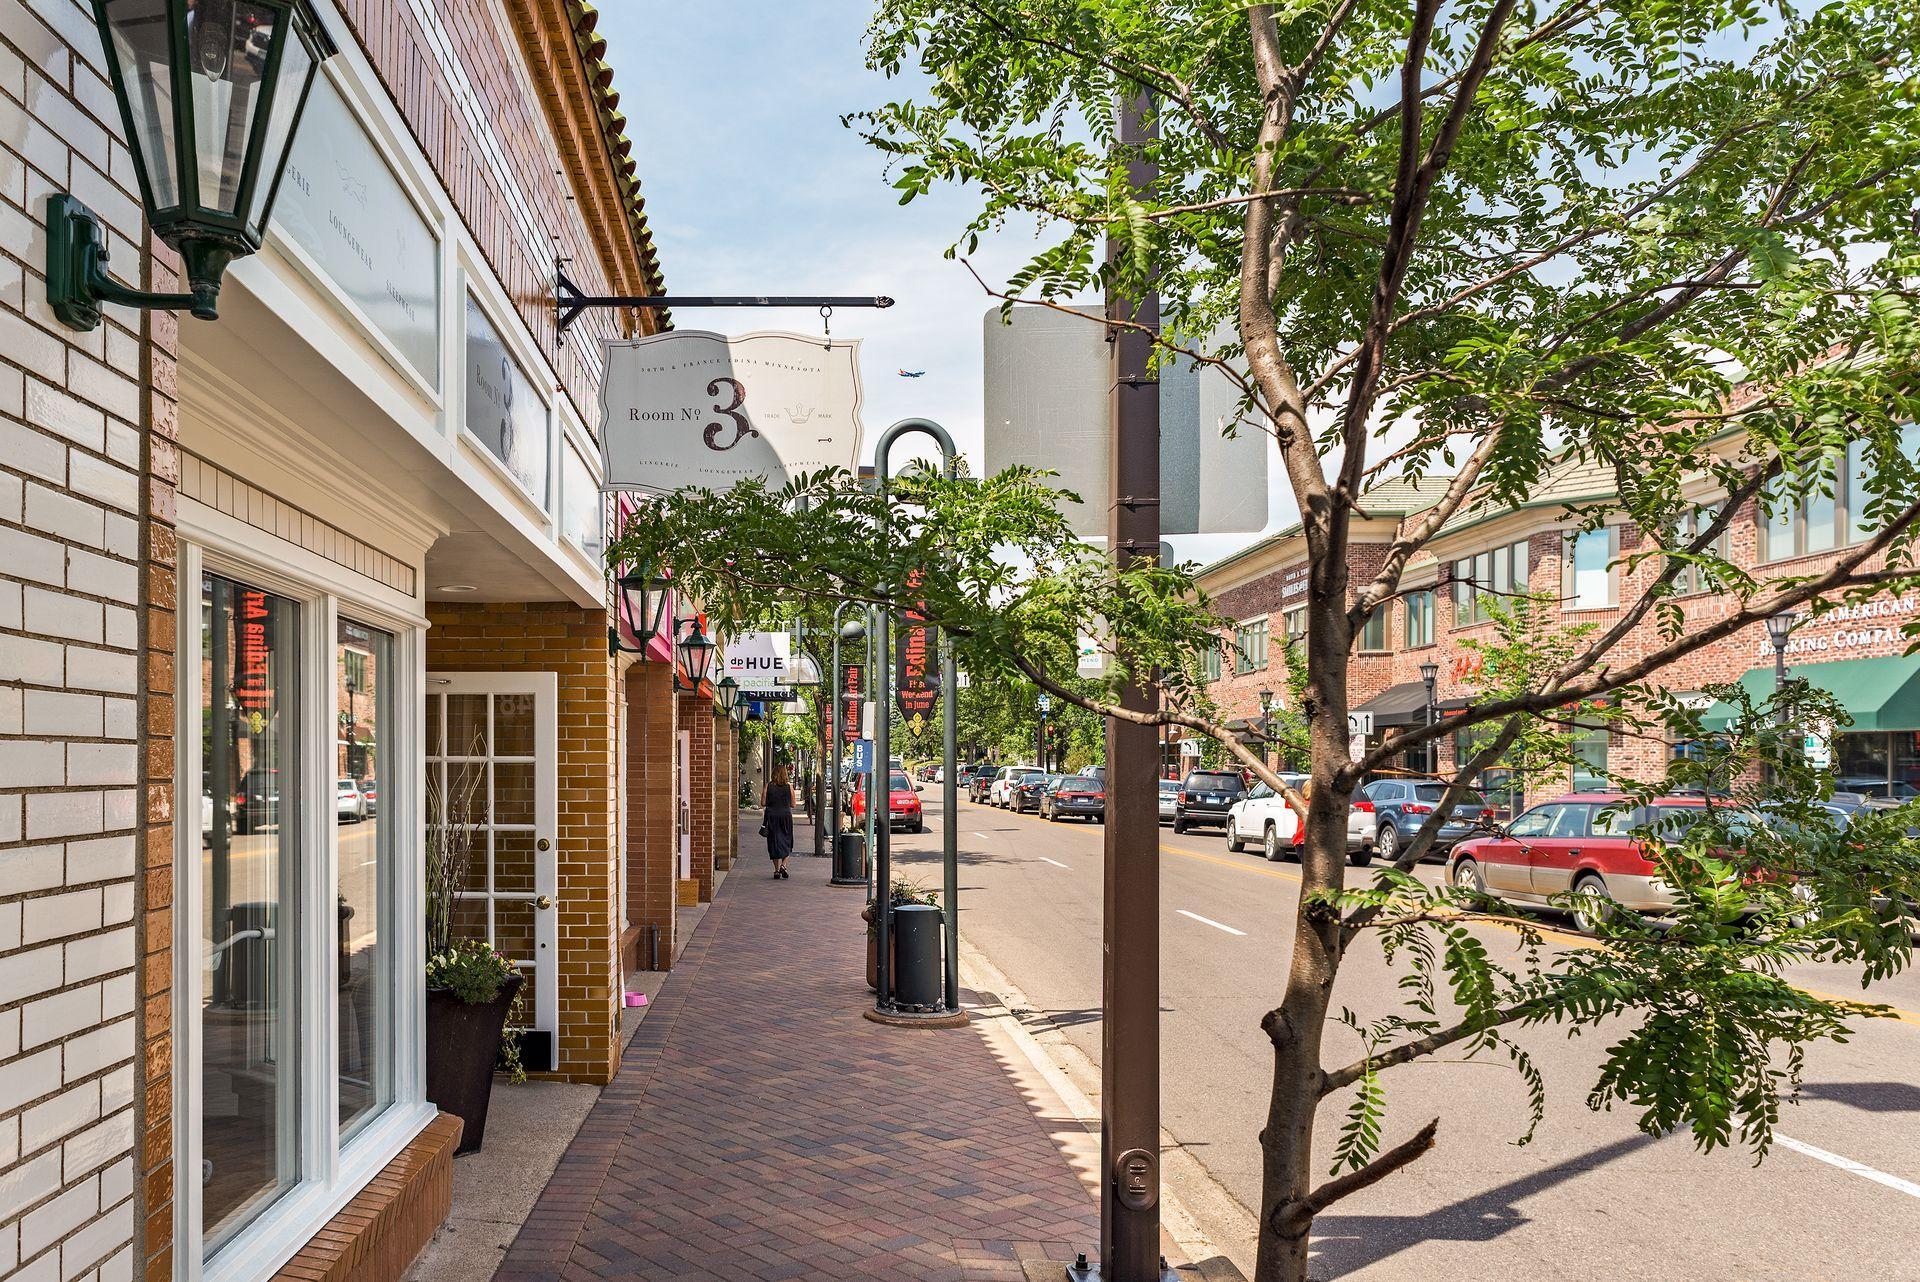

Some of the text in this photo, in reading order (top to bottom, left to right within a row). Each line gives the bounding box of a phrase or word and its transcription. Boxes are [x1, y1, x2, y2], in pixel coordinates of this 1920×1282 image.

[683, 358, 721, 368] FRANCE
[765, 361, 821, 373] MINNESOTA
[629, 408, 674, 421] Room
[703, 377, 759, 451] 3
[1823, 597, 1915, 623] AMERICAN
[905, 625, 926, 678] Edina
[847, 666, 858, 684] Fair
[847, 685, 858, 699] Art
[847, 701, 858, 726] Edina
[856, 744, 864, 767] BUS
